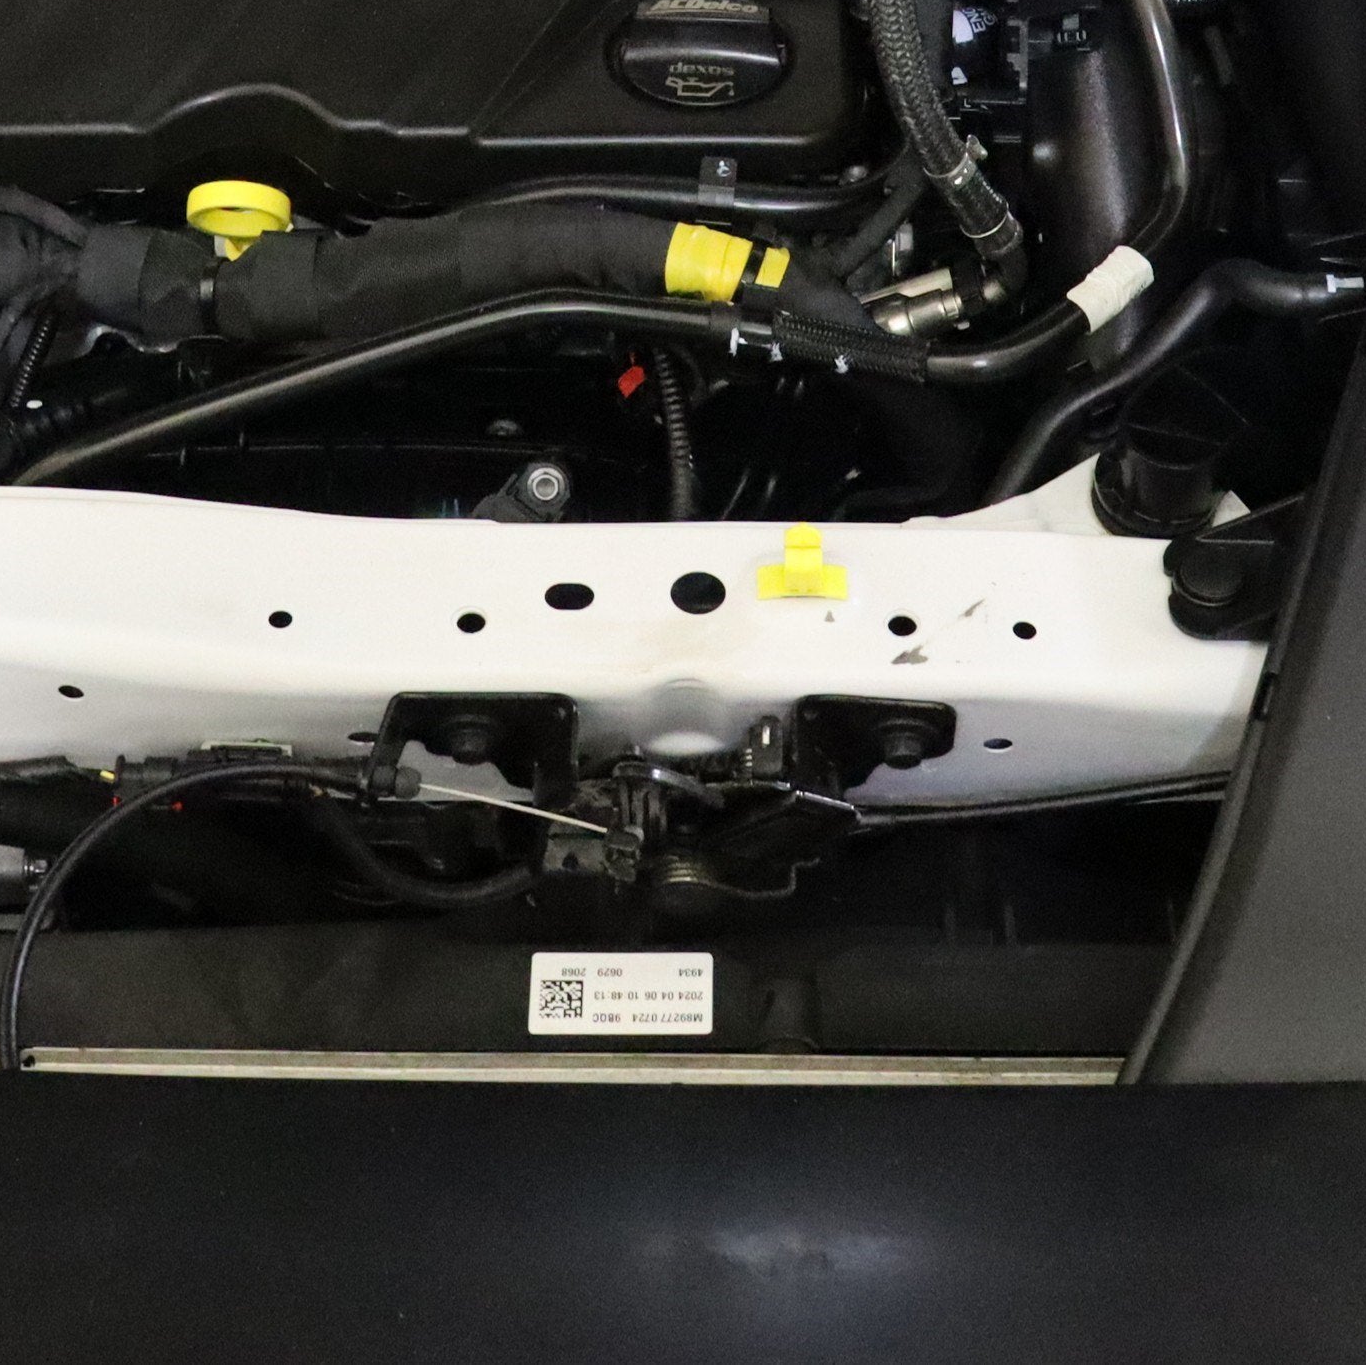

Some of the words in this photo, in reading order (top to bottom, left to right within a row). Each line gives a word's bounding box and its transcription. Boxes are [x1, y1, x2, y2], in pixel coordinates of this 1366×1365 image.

[668, 62, 735, 75] dexos
[561, 967, 586, 977] 2068
[597, 968, 623, 977] 0629
[678, 968, 703, 977] 4934
[632, 1013, 657, 1022] 0724
[660, 1013, 703, 1022] M89277
